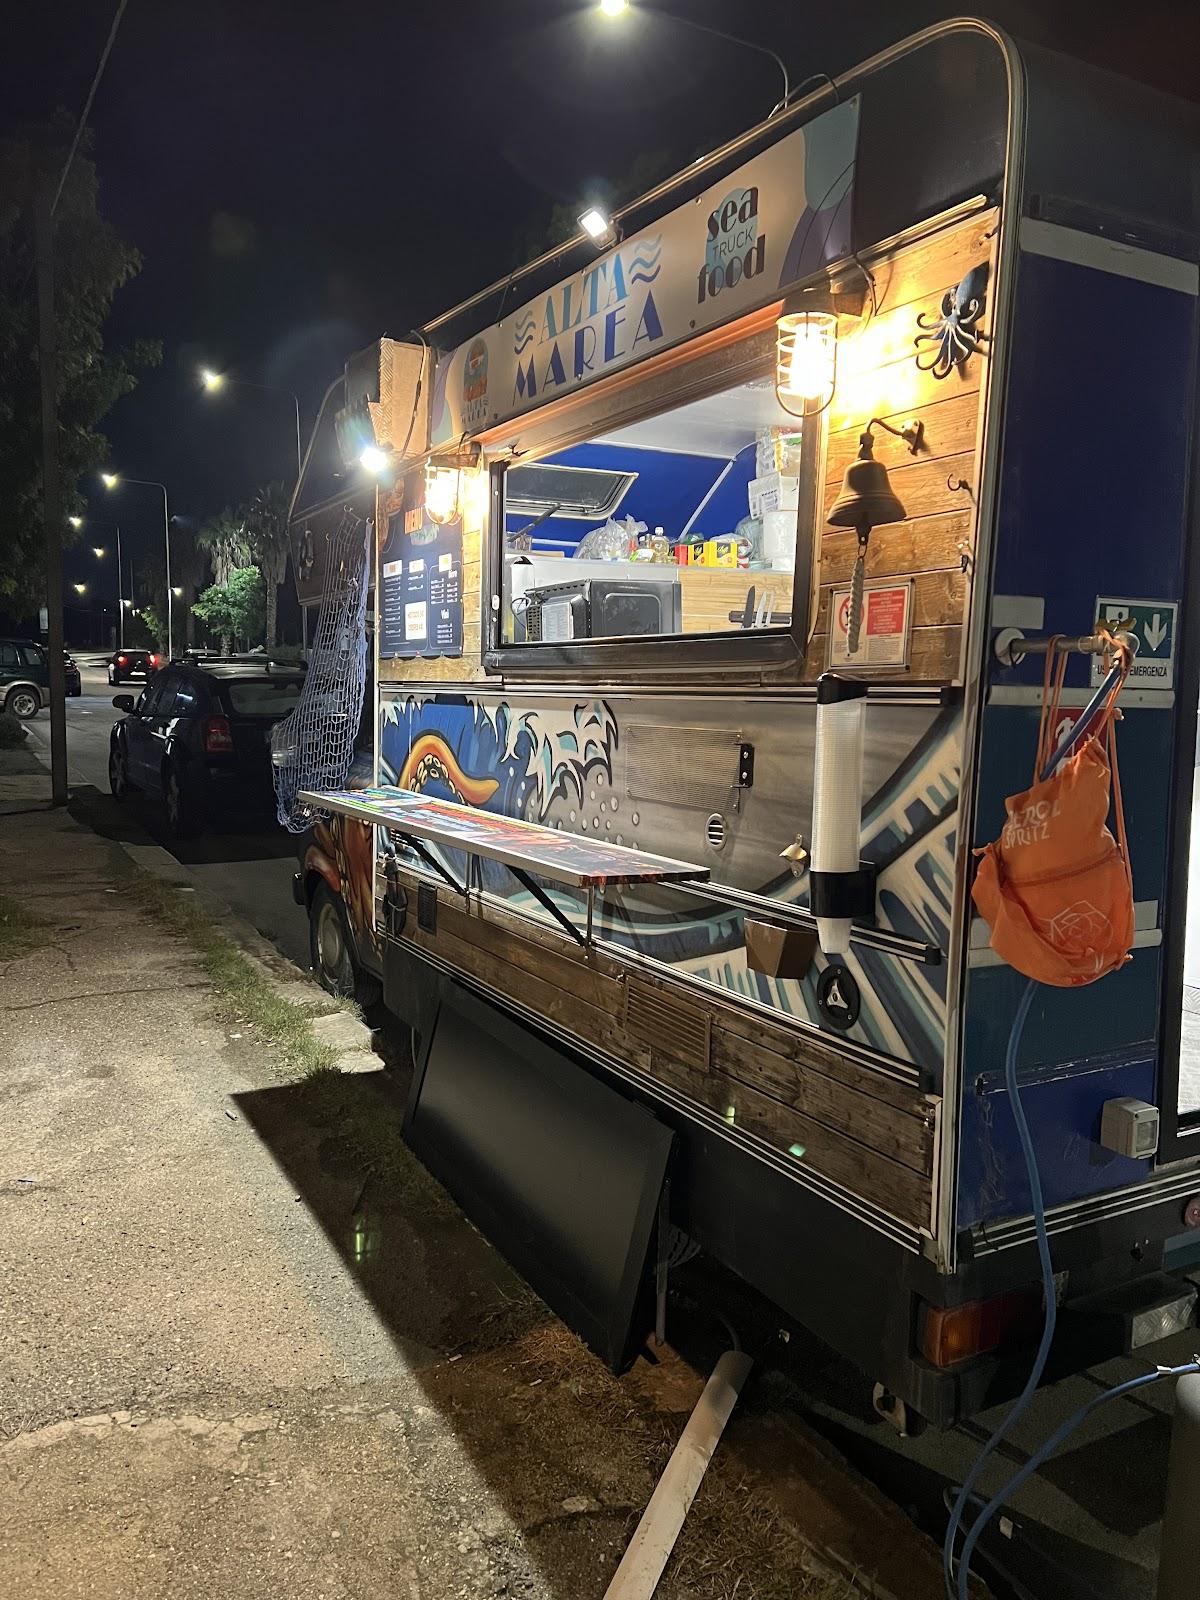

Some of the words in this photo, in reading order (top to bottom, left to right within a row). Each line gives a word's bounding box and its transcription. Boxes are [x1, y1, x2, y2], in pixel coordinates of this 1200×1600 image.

[706, 185, 759, 241] sea
[712, 229, 754, 257] TRUCK
[537, 252, 631, 346] ALTA
[696, 233, 766, 304] food
[511, 289, 664, 407] MAREA
[1129, 666, 1168, 677] EMERGENZA
